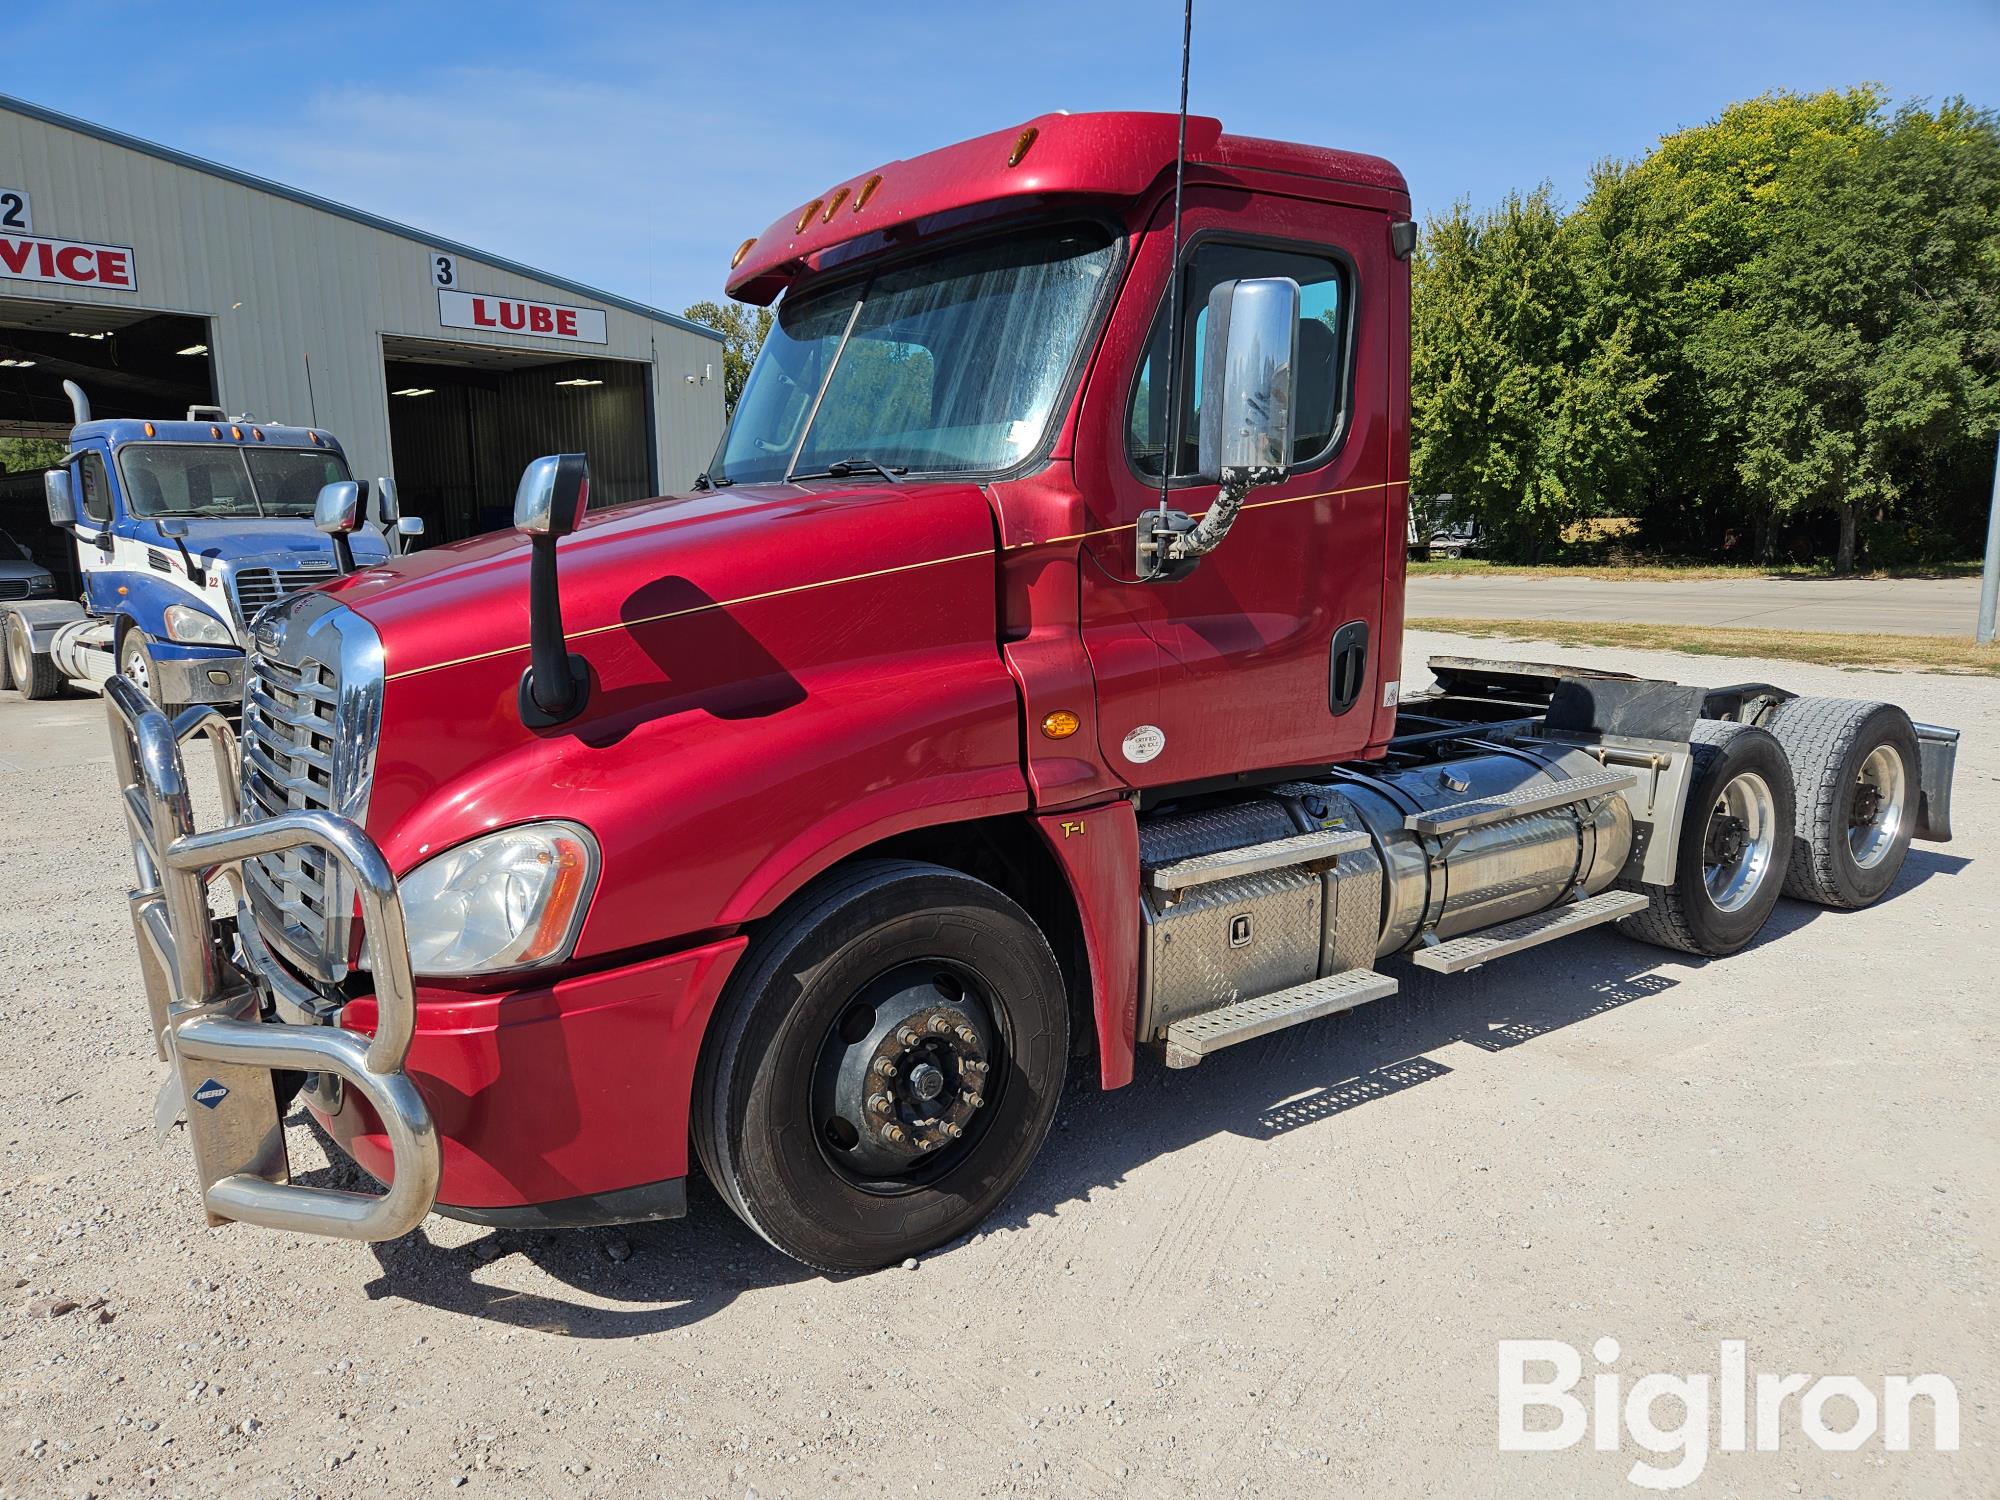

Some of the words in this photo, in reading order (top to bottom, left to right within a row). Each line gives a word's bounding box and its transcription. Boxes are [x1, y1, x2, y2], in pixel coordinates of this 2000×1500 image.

[0, 193, 25, 228] 2
[0, 239, 129, 285] VICE
[436, 257, 453, 285] 3
[472, 298, 577, 337] LUBE
[196, 1088, 227, 1100] HERD
